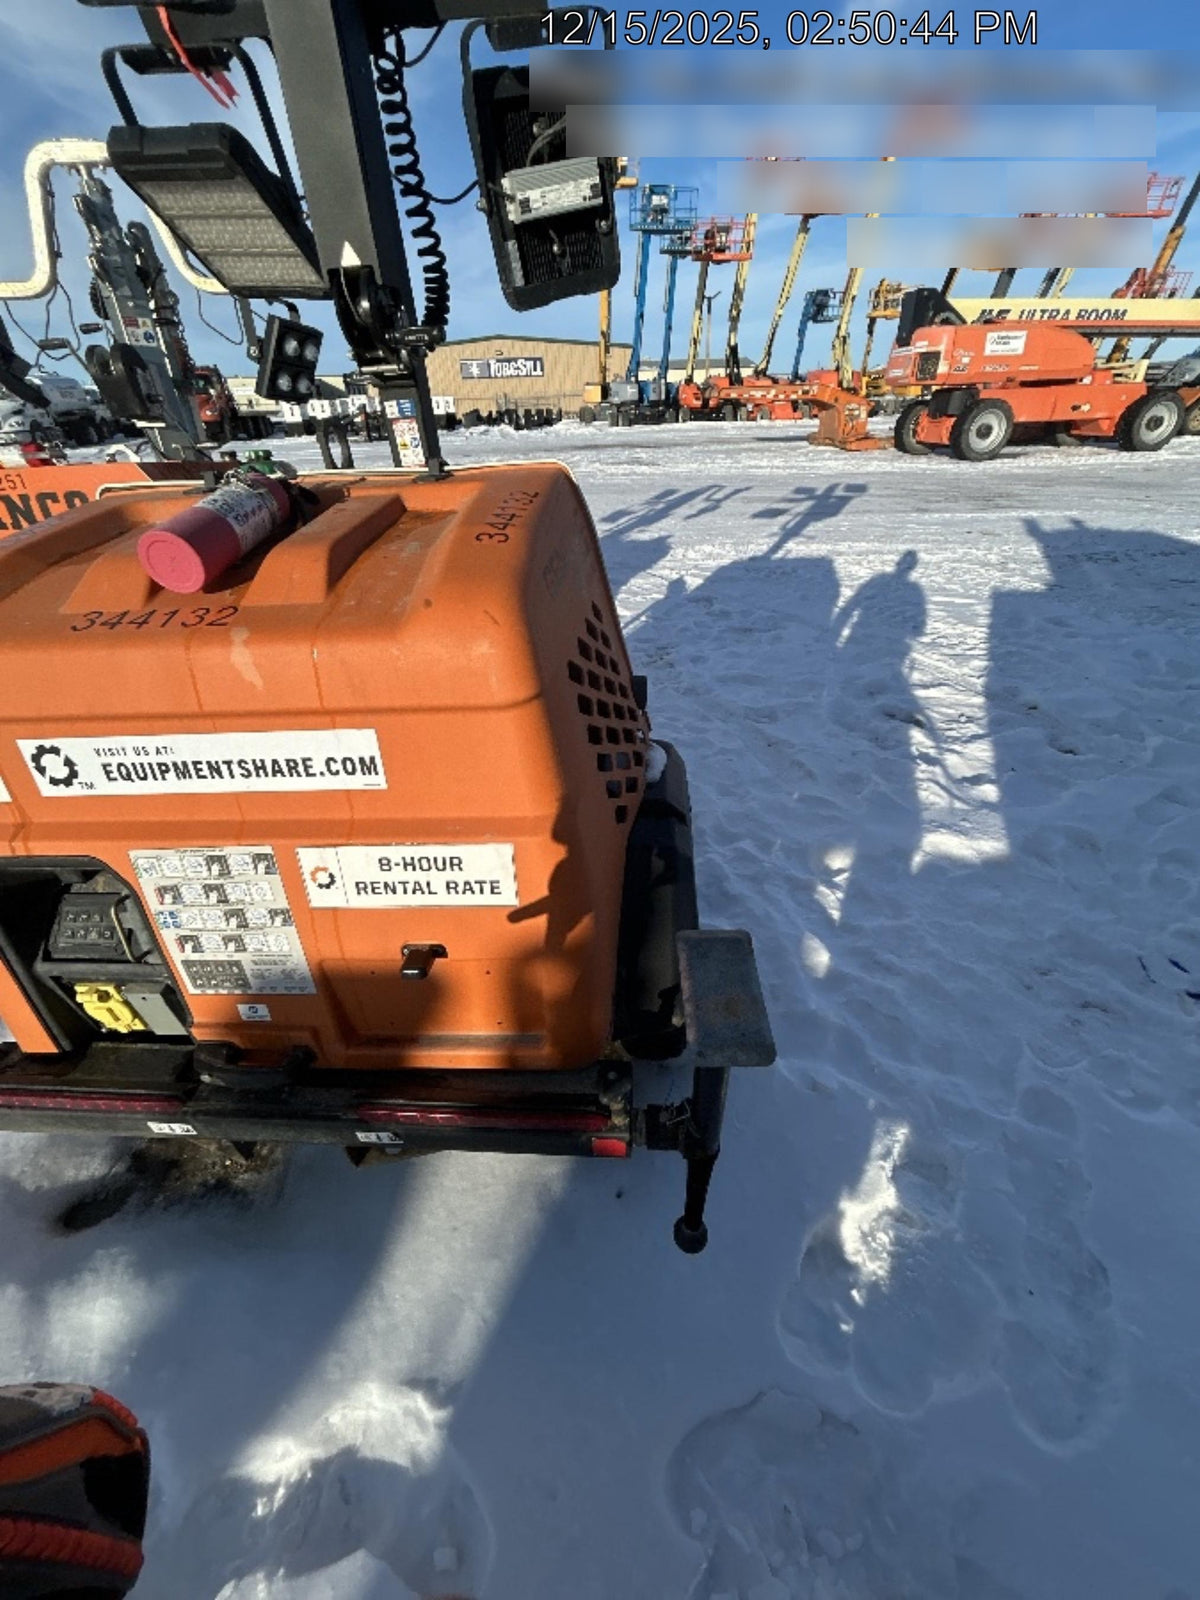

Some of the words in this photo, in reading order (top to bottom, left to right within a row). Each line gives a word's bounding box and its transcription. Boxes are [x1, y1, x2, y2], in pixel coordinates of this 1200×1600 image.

[70, 605, 239, 632] 344132
[94, 747, 128, 758] VISIT
[132, 746, 150, 756] US
[101, 755, 379, 783] EQUIPMENTSHARE.COM
[378, 856, 463, 872] 8-HOUR
[355, 880, 438, 895] RENTAL
[445, 879, 501, 895] RATE
